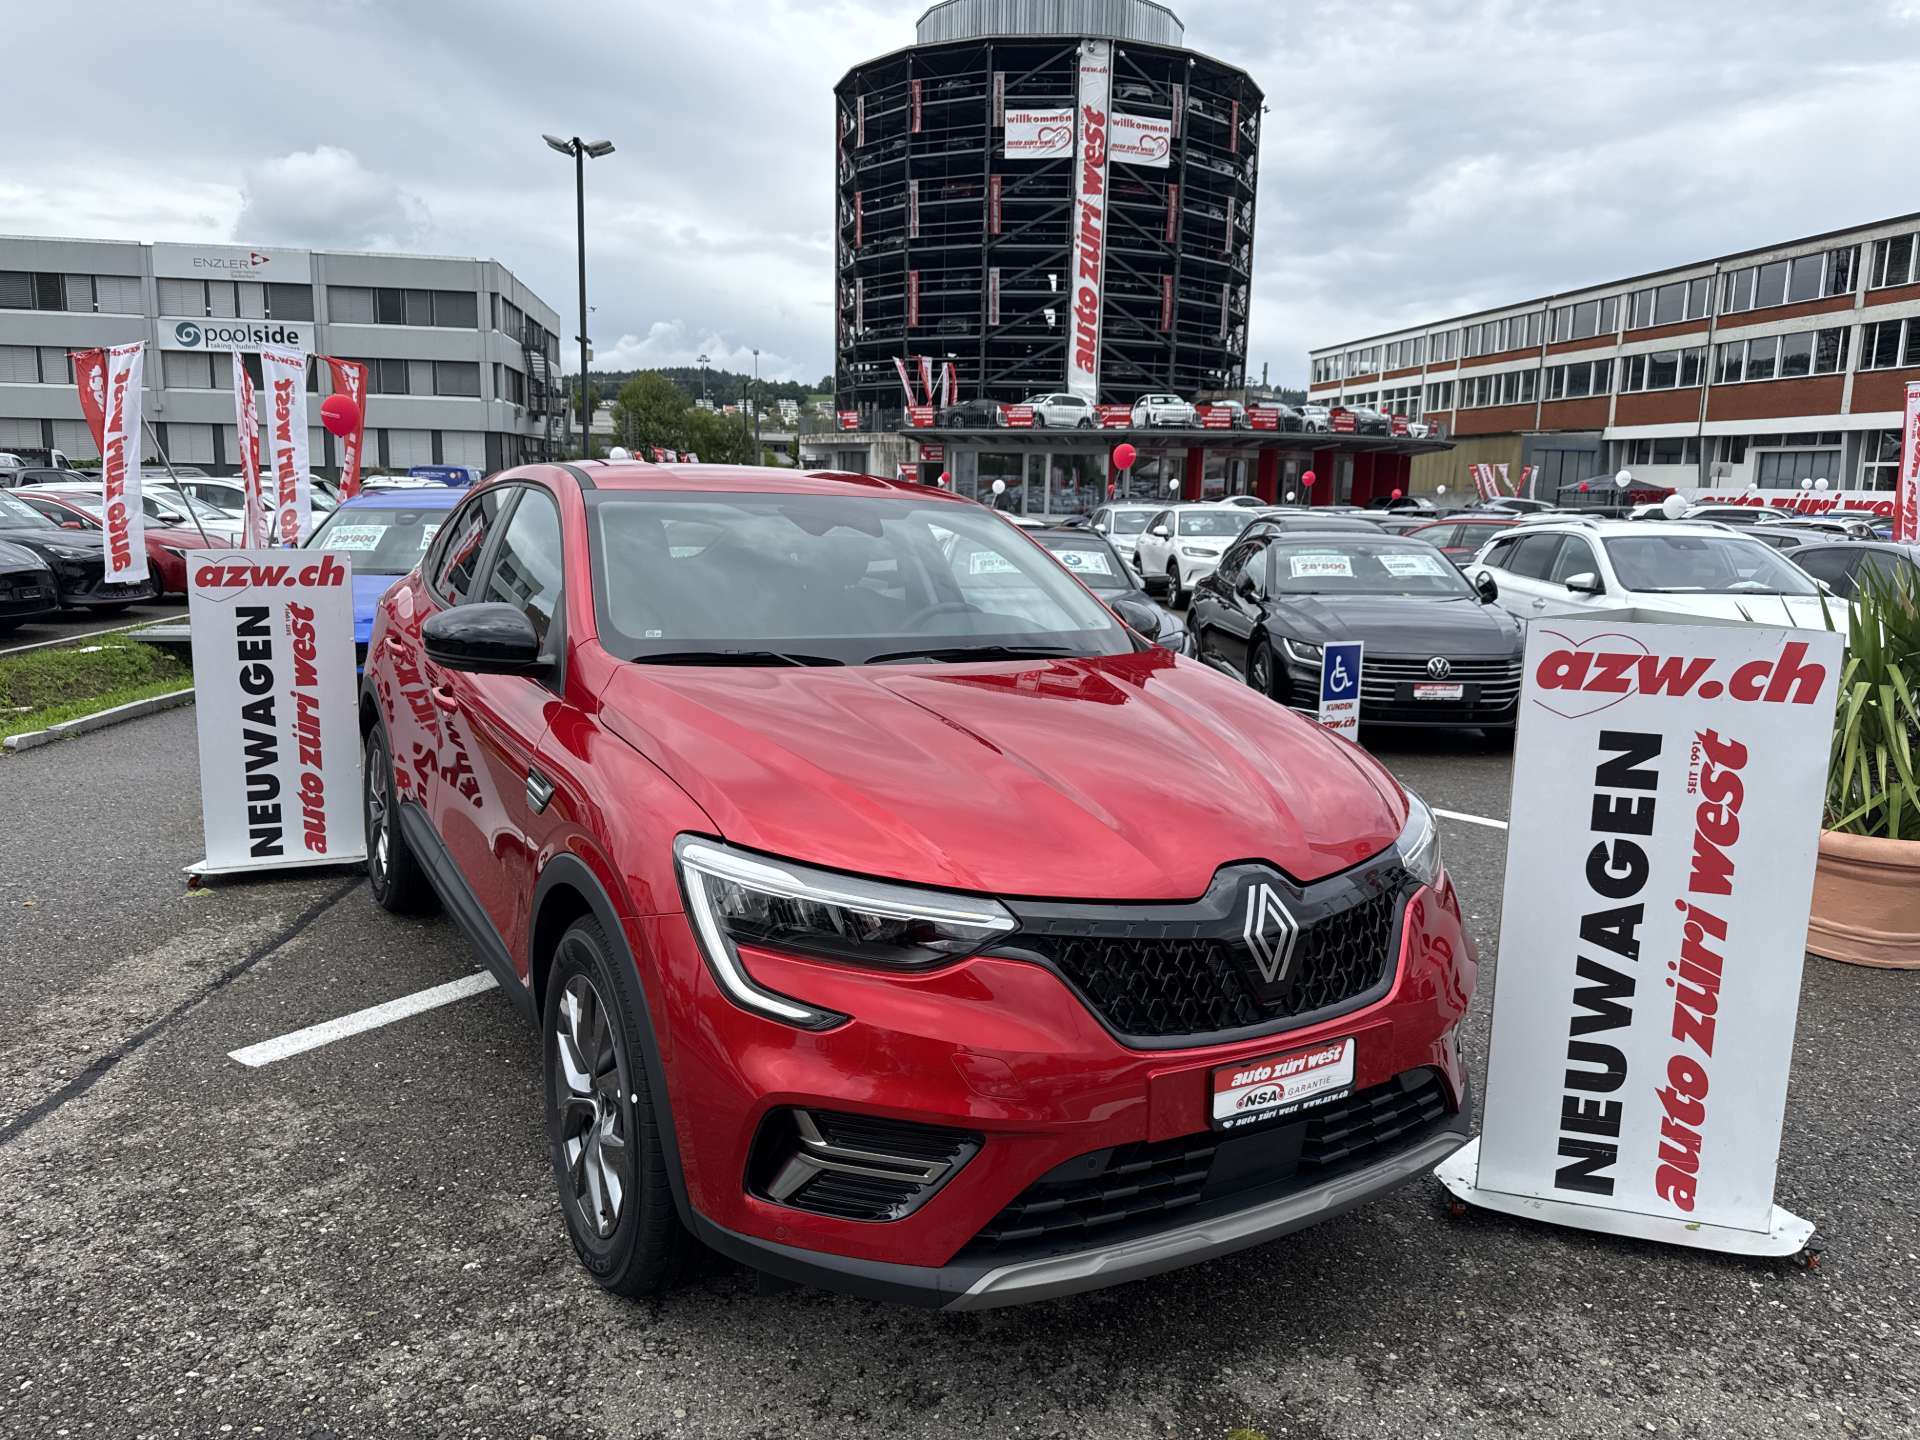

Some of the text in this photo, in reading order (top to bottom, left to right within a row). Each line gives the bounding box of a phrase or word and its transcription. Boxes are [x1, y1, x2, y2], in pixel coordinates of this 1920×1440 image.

[1006, 114, 1072, 124] willkommen
[1112, 118, 1170, 133] willkommen
[1075, 106, 1106, 375] auto züri west
[193, 257, 249, 269] ENZLER
[204, 325, 299, 347] poolside
[333, 534, 376, 544] 29'800
[195, 554, 345, 588] azw.ch
[1301, 562, 1346, 571] 28'800
[1536, 642, 1826, 705] azw.ch
[1325, 702, 1354, 712] KUNDEN
[236, 606, 284, 858] NEUWAGEN
[287, 602, 327, 854] auto züri west
[1687, 740, 1701, 794] SEIT 1991
[1555, 730, 1663, 1197] NEUWAGEN
[1656, 728, 1749, 1213] auto züri west
[1231, 1045, 1343, 1087] auto züri west
[1244, 1089, 1279, 1108] NSA
[1287, 1076, 1332, 1097] GARANTIE
[1235, 1115, 1256, 1126] auto
[1279, 1104, 1299, 1117] west
[1303, 1090, 1349, 1110] www.azw.ch
